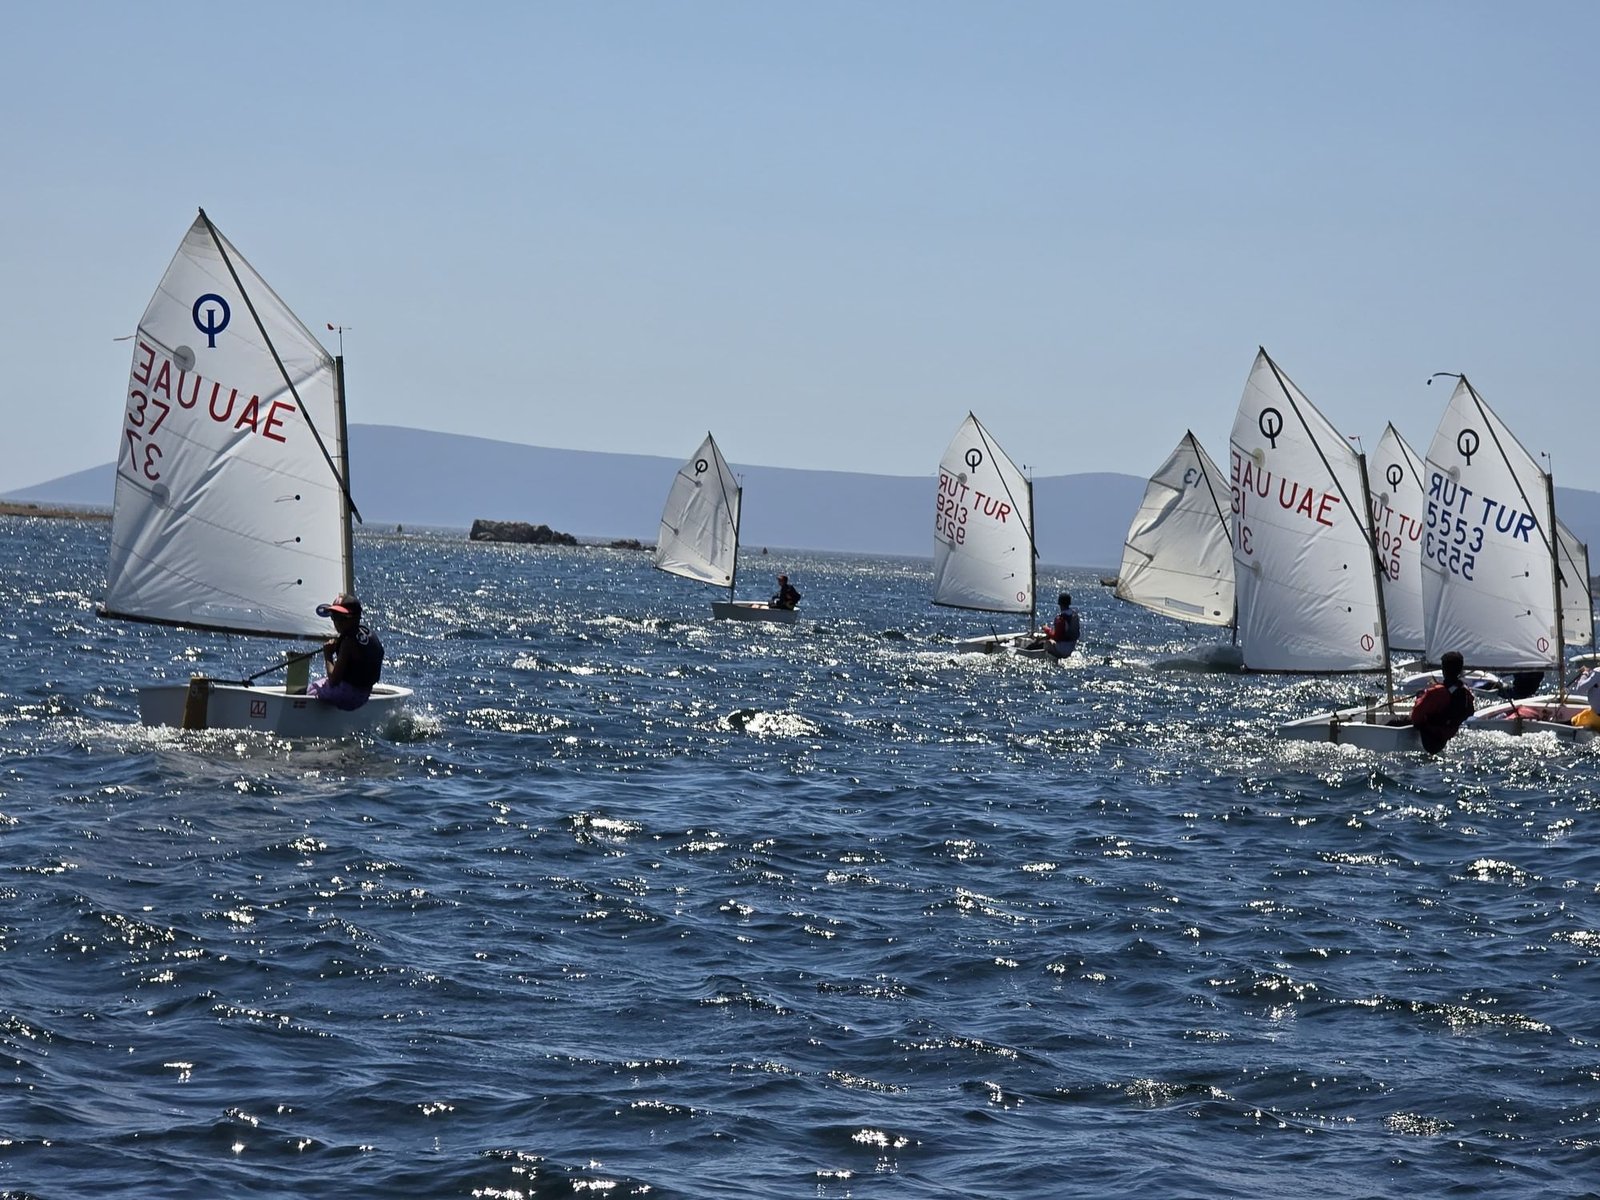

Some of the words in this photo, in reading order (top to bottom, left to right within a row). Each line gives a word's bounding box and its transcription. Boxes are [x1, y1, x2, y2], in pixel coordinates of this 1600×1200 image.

[128, 390, 170, 435] 37
[209, 382, 296, 443] UAE
[937, 493, 968, 524] 9213
[974, 491, 1011, 523] TUR
[1231, 486, 1246, 520] 31
[1279, 478, 1340, 527] UAE
[1482, 497, 1536, 543] TUR
[1400, 514, 1423, 541] TU
[1427, 501, 1484, 553] 5553
